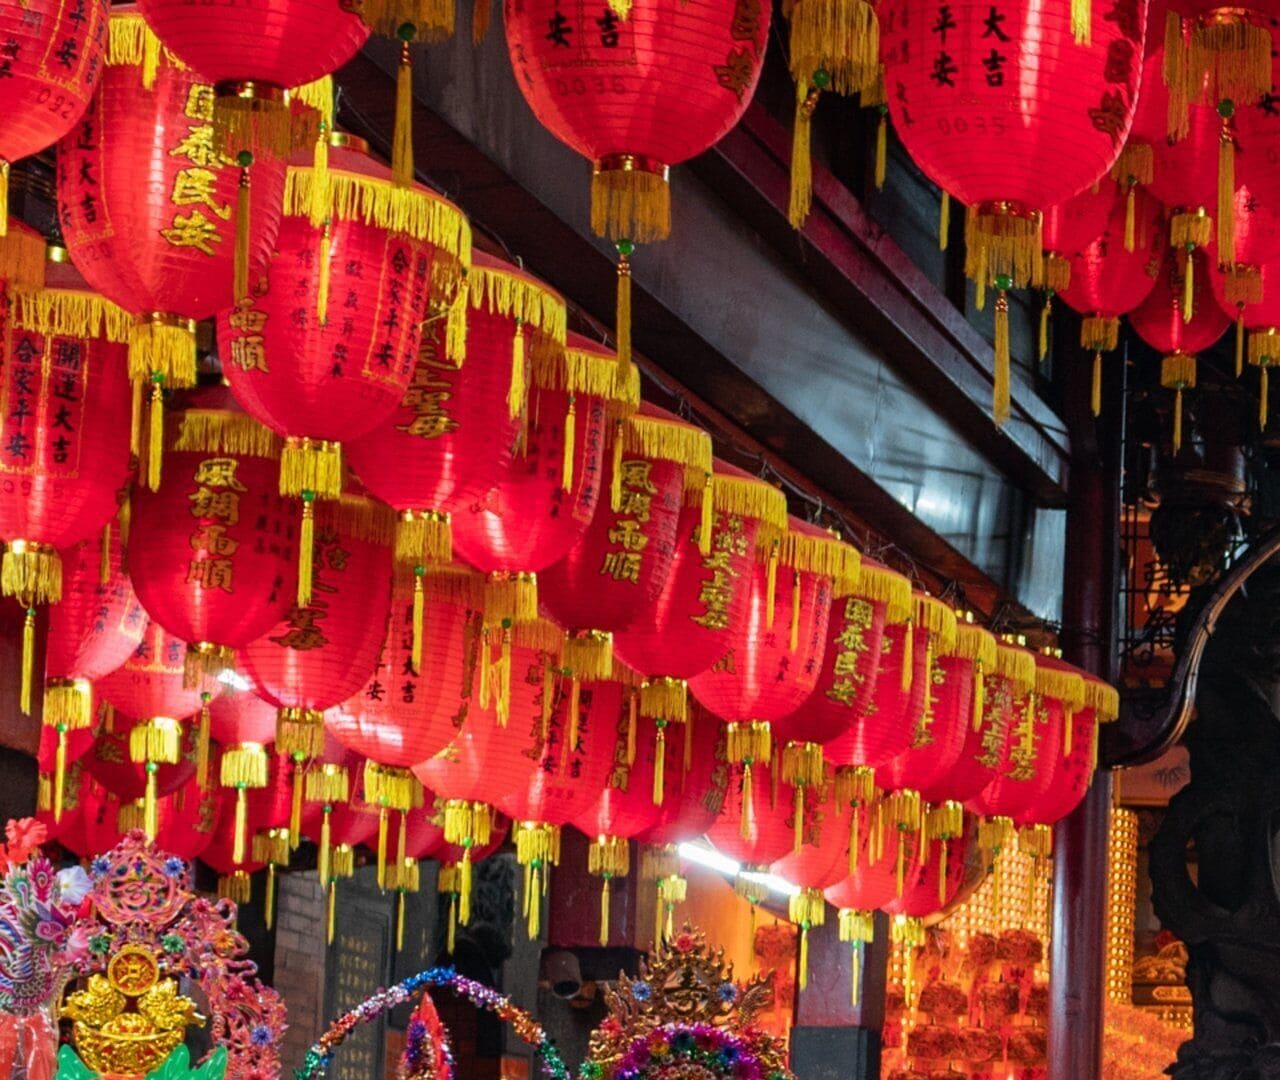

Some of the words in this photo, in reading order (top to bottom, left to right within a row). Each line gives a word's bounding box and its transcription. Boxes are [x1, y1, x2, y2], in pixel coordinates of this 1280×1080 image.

[546, 13, 572, 47] 安
[596, 11, 619, 47] 吉
[930, 6, 959, 88] 平安
[980, 6, 1010, 88] 大吉
[374, 247, 409, 369] 合家平安
[5, 338, 39, 460] 合家平安
[52, 341, 82, 464] 開運大吉
[187, 456, 249, 594] 風調雨順
[600, 459, 659, 585] 風調雨順
[825, 597, 875, 707] 國泰民安
